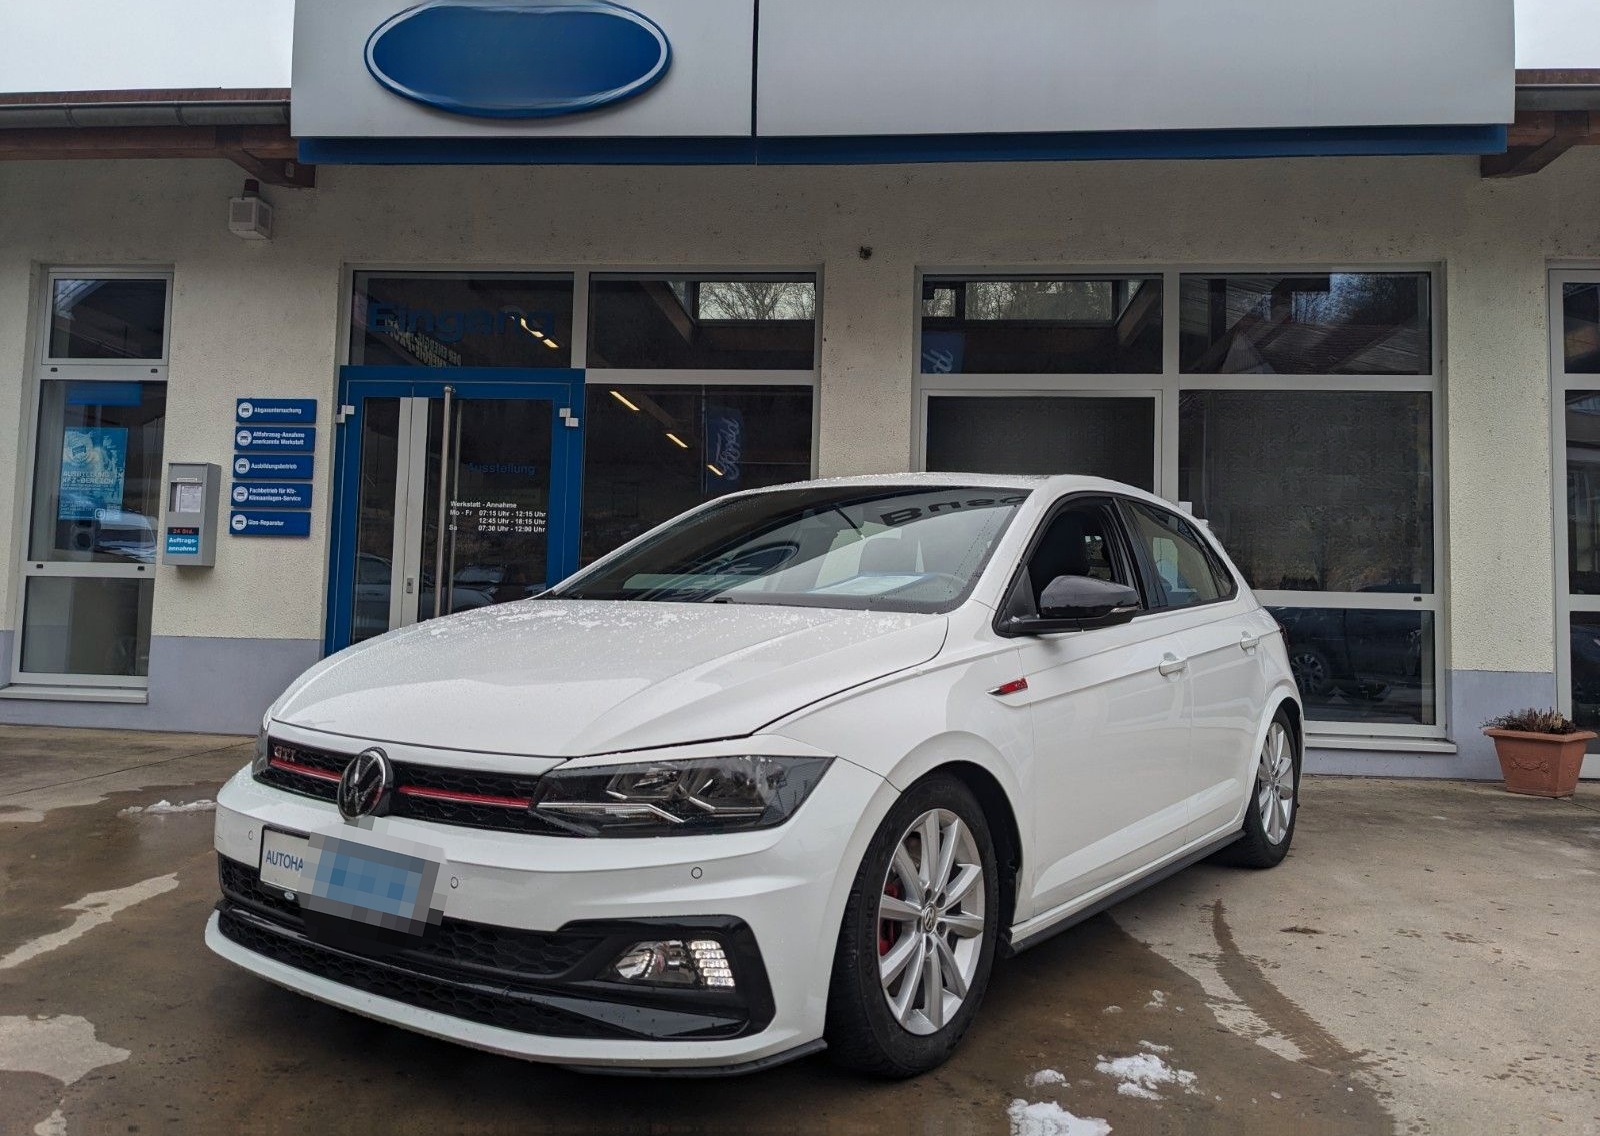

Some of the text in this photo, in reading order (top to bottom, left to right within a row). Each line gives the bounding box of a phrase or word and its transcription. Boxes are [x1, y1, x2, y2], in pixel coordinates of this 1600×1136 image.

[367, 302, 555, 343] Eingang
[468, 462, 536, 476] Ausstellung
[450, 500, 481, 508] Werkstatt
[486, 501, 517, 509] Annahme
[478, 509, 497, 517] 07:15
